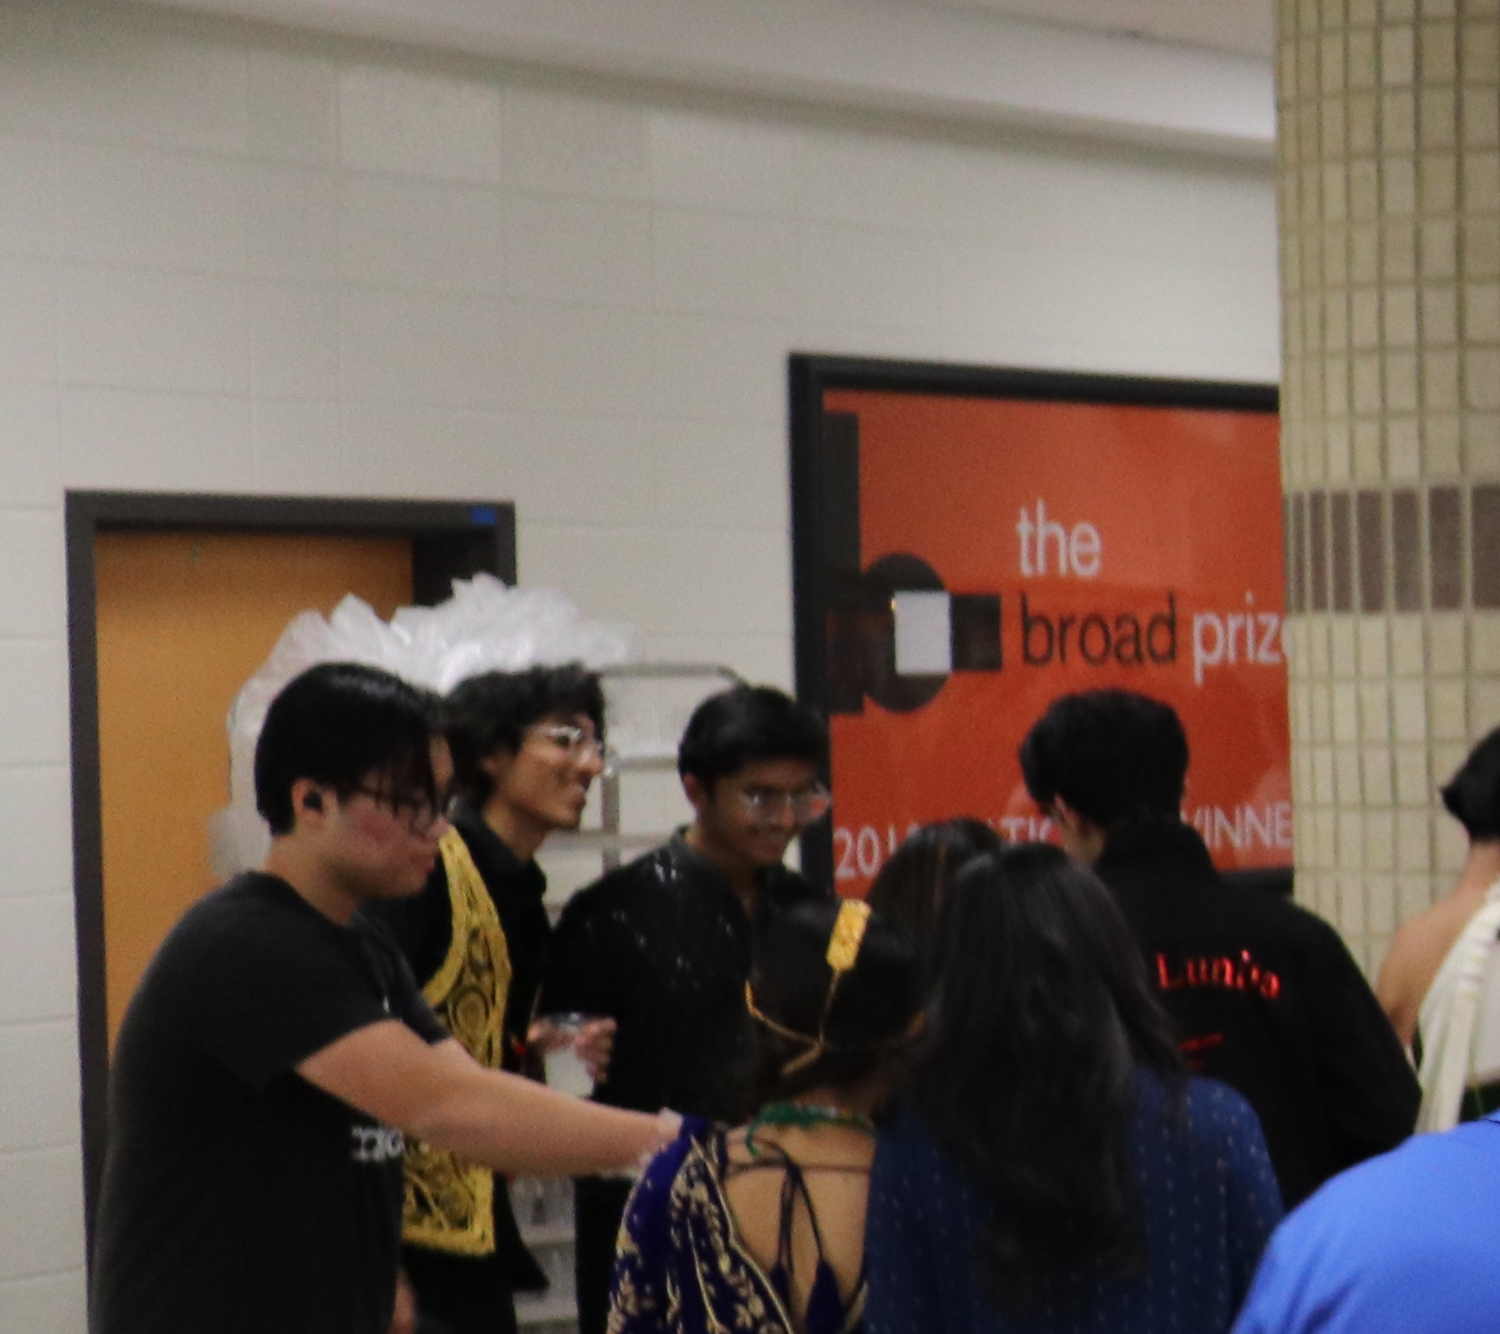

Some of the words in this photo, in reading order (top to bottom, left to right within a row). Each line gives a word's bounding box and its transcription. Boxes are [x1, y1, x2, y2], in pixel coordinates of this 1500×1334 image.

[1015, 498, 1102, 577] the
[1021, 589, 1176, 668] broad
[1194, 590, 1289, 686] priz
[833, 822, 922, 881] 201
